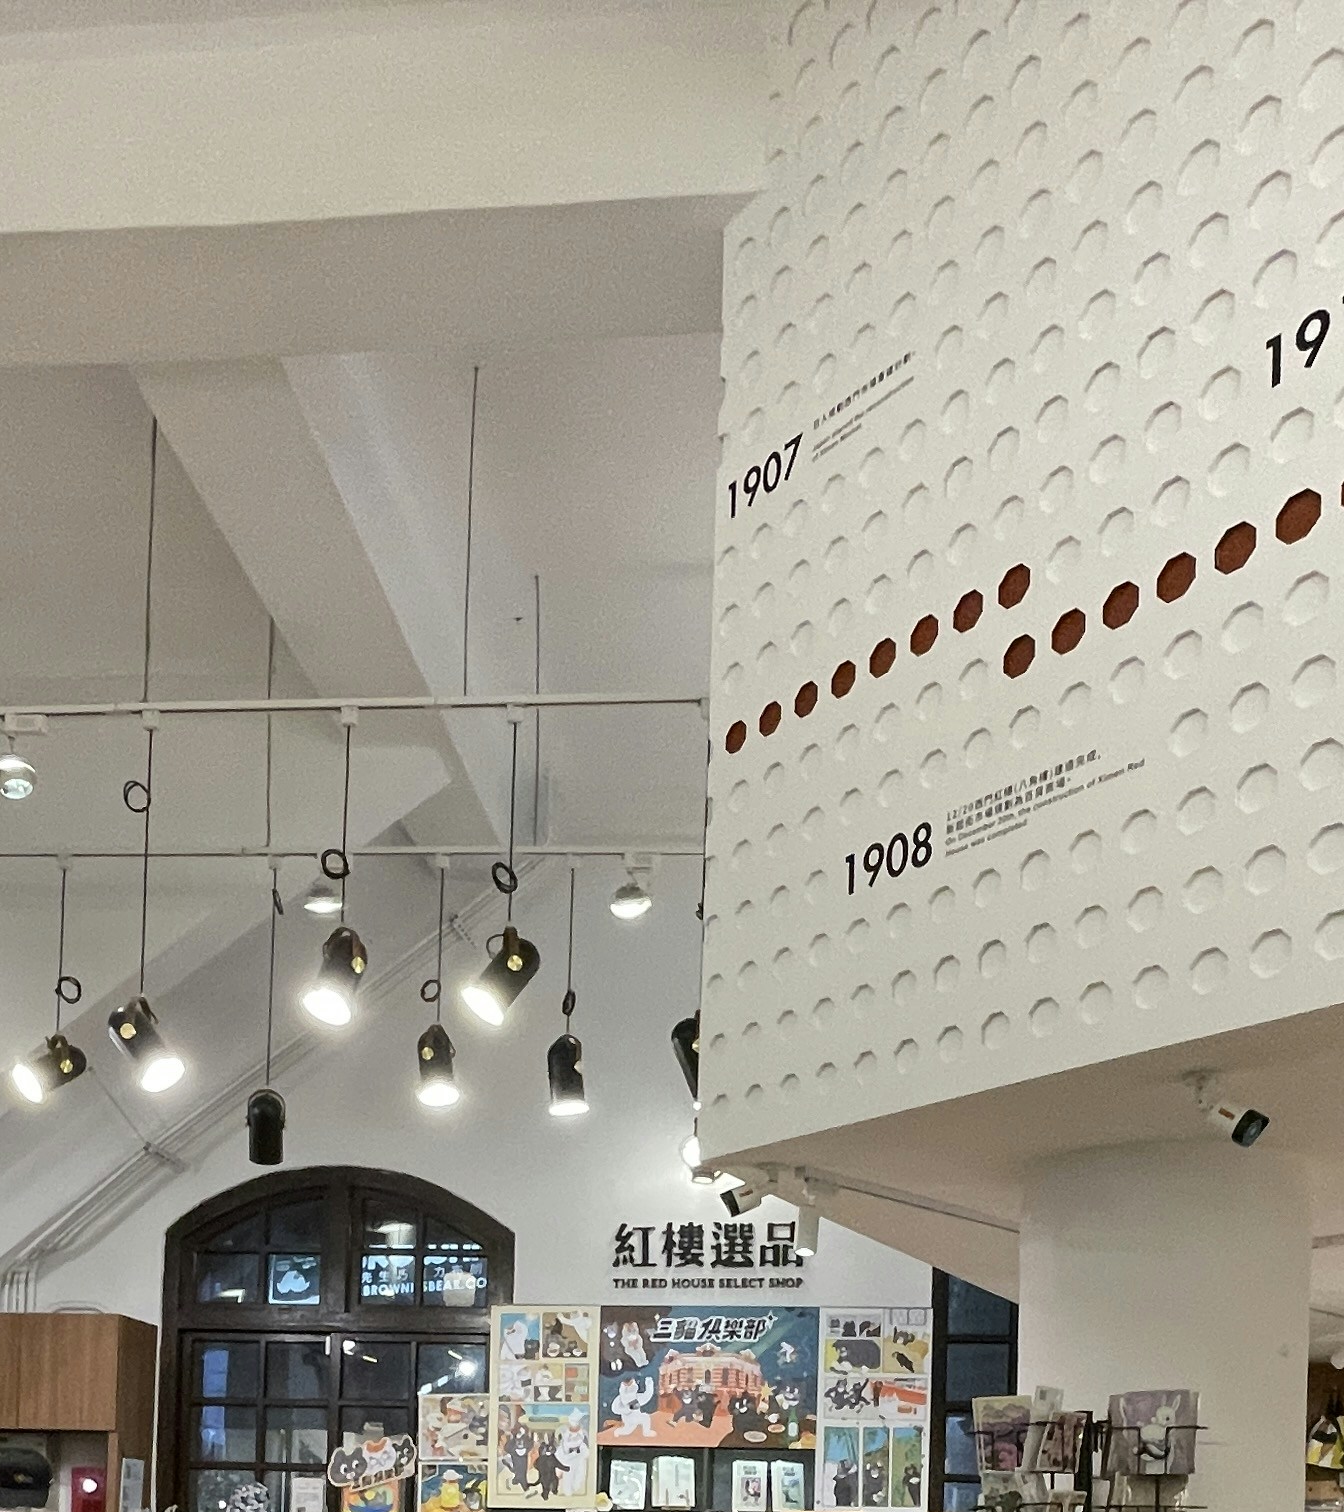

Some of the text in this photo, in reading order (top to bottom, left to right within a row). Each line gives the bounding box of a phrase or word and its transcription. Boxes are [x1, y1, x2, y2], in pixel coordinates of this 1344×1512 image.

[728, 432, 804, 519] 1907
[845, 821, 934, 896] 1908
[612, 1221, 804, 1268] 紅樓選品
[612, 1278, 804, 1289] THE RED HOUSE SELECT SHOP
